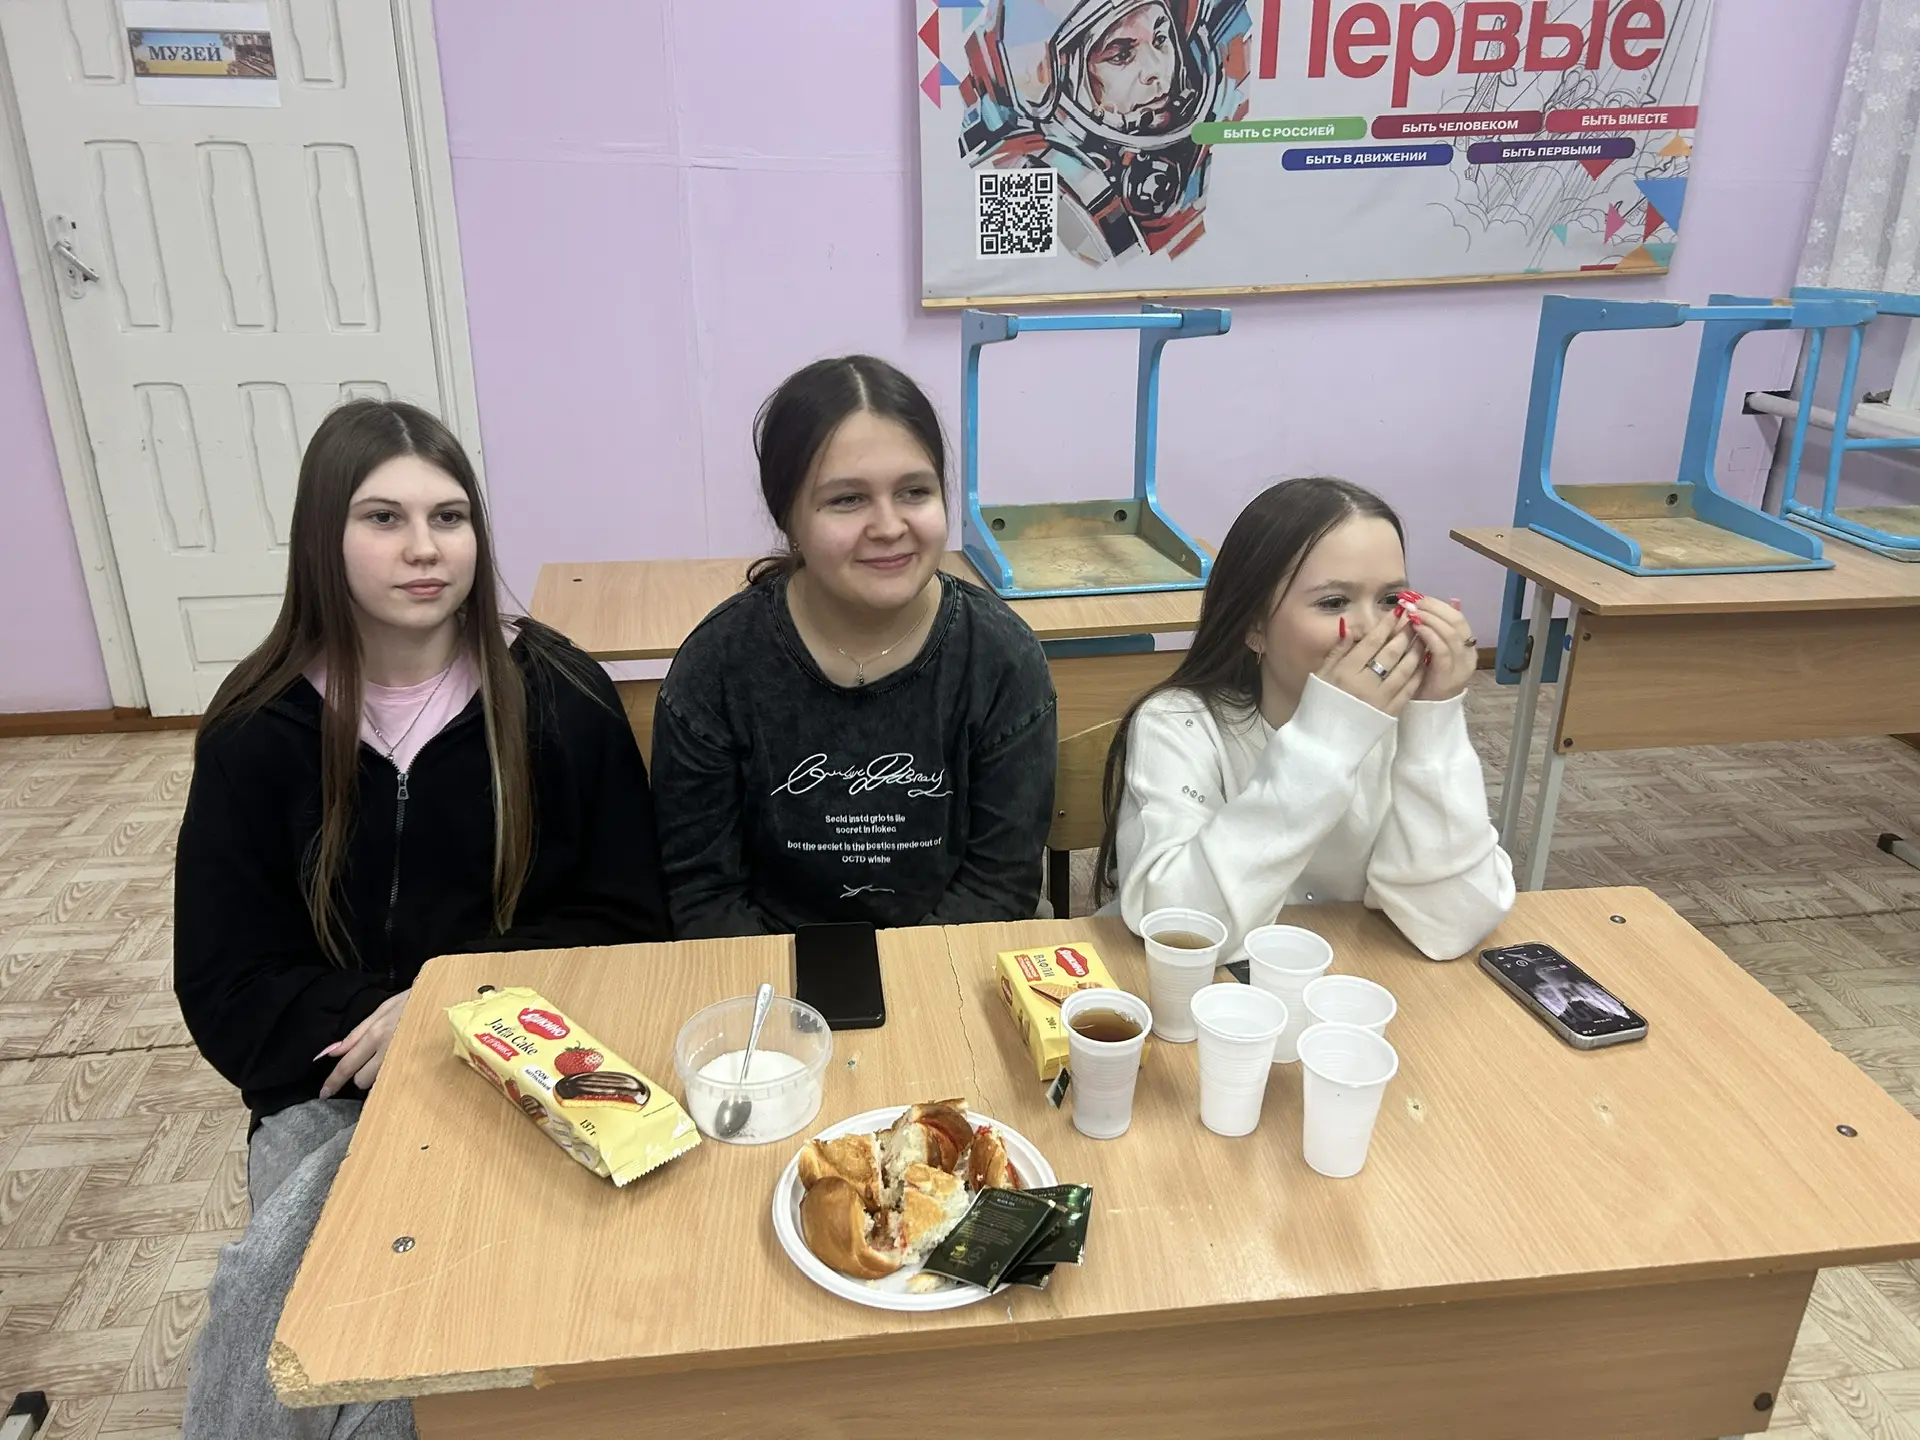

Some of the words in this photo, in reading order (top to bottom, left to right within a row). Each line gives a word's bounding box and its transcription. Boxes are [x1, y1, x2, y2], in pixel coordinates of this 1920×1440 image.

[148, 42, 222, 62] МУЗЕЙ
[1402, 122, 1437, 133] БЫТЬ
[1439, 119, 1519, 132] ЧЕЛОВЕКОМ
[1581, 114, 1616, 126] БЫТЬ
[1619, 113, 1669, 125] ВМЕСТЕ
[1223, 128, 1259, 139] БЫТЬ
[1262, 127, 1272, 138] С
[1273, 123, 1335, 138] РОССИЕЙ
[1306, 154, 1341, 165] БЫТЬ
[1343, 153, 1352, 164] В
[1354, 151, 1427, 165] ДВИЖЕНИИ
[1502, 147, 1537, 158] БЫТЬ
[1539, 145, 1602, 157] ПЕРВЫМИ
[852, 841, 865, 851] the
[919, 839, 933, 848] out
[933, 836, 942, 846] of
[511, 1035, 538, 1056] Cake
[579, 1118, 594, 1134] 137
